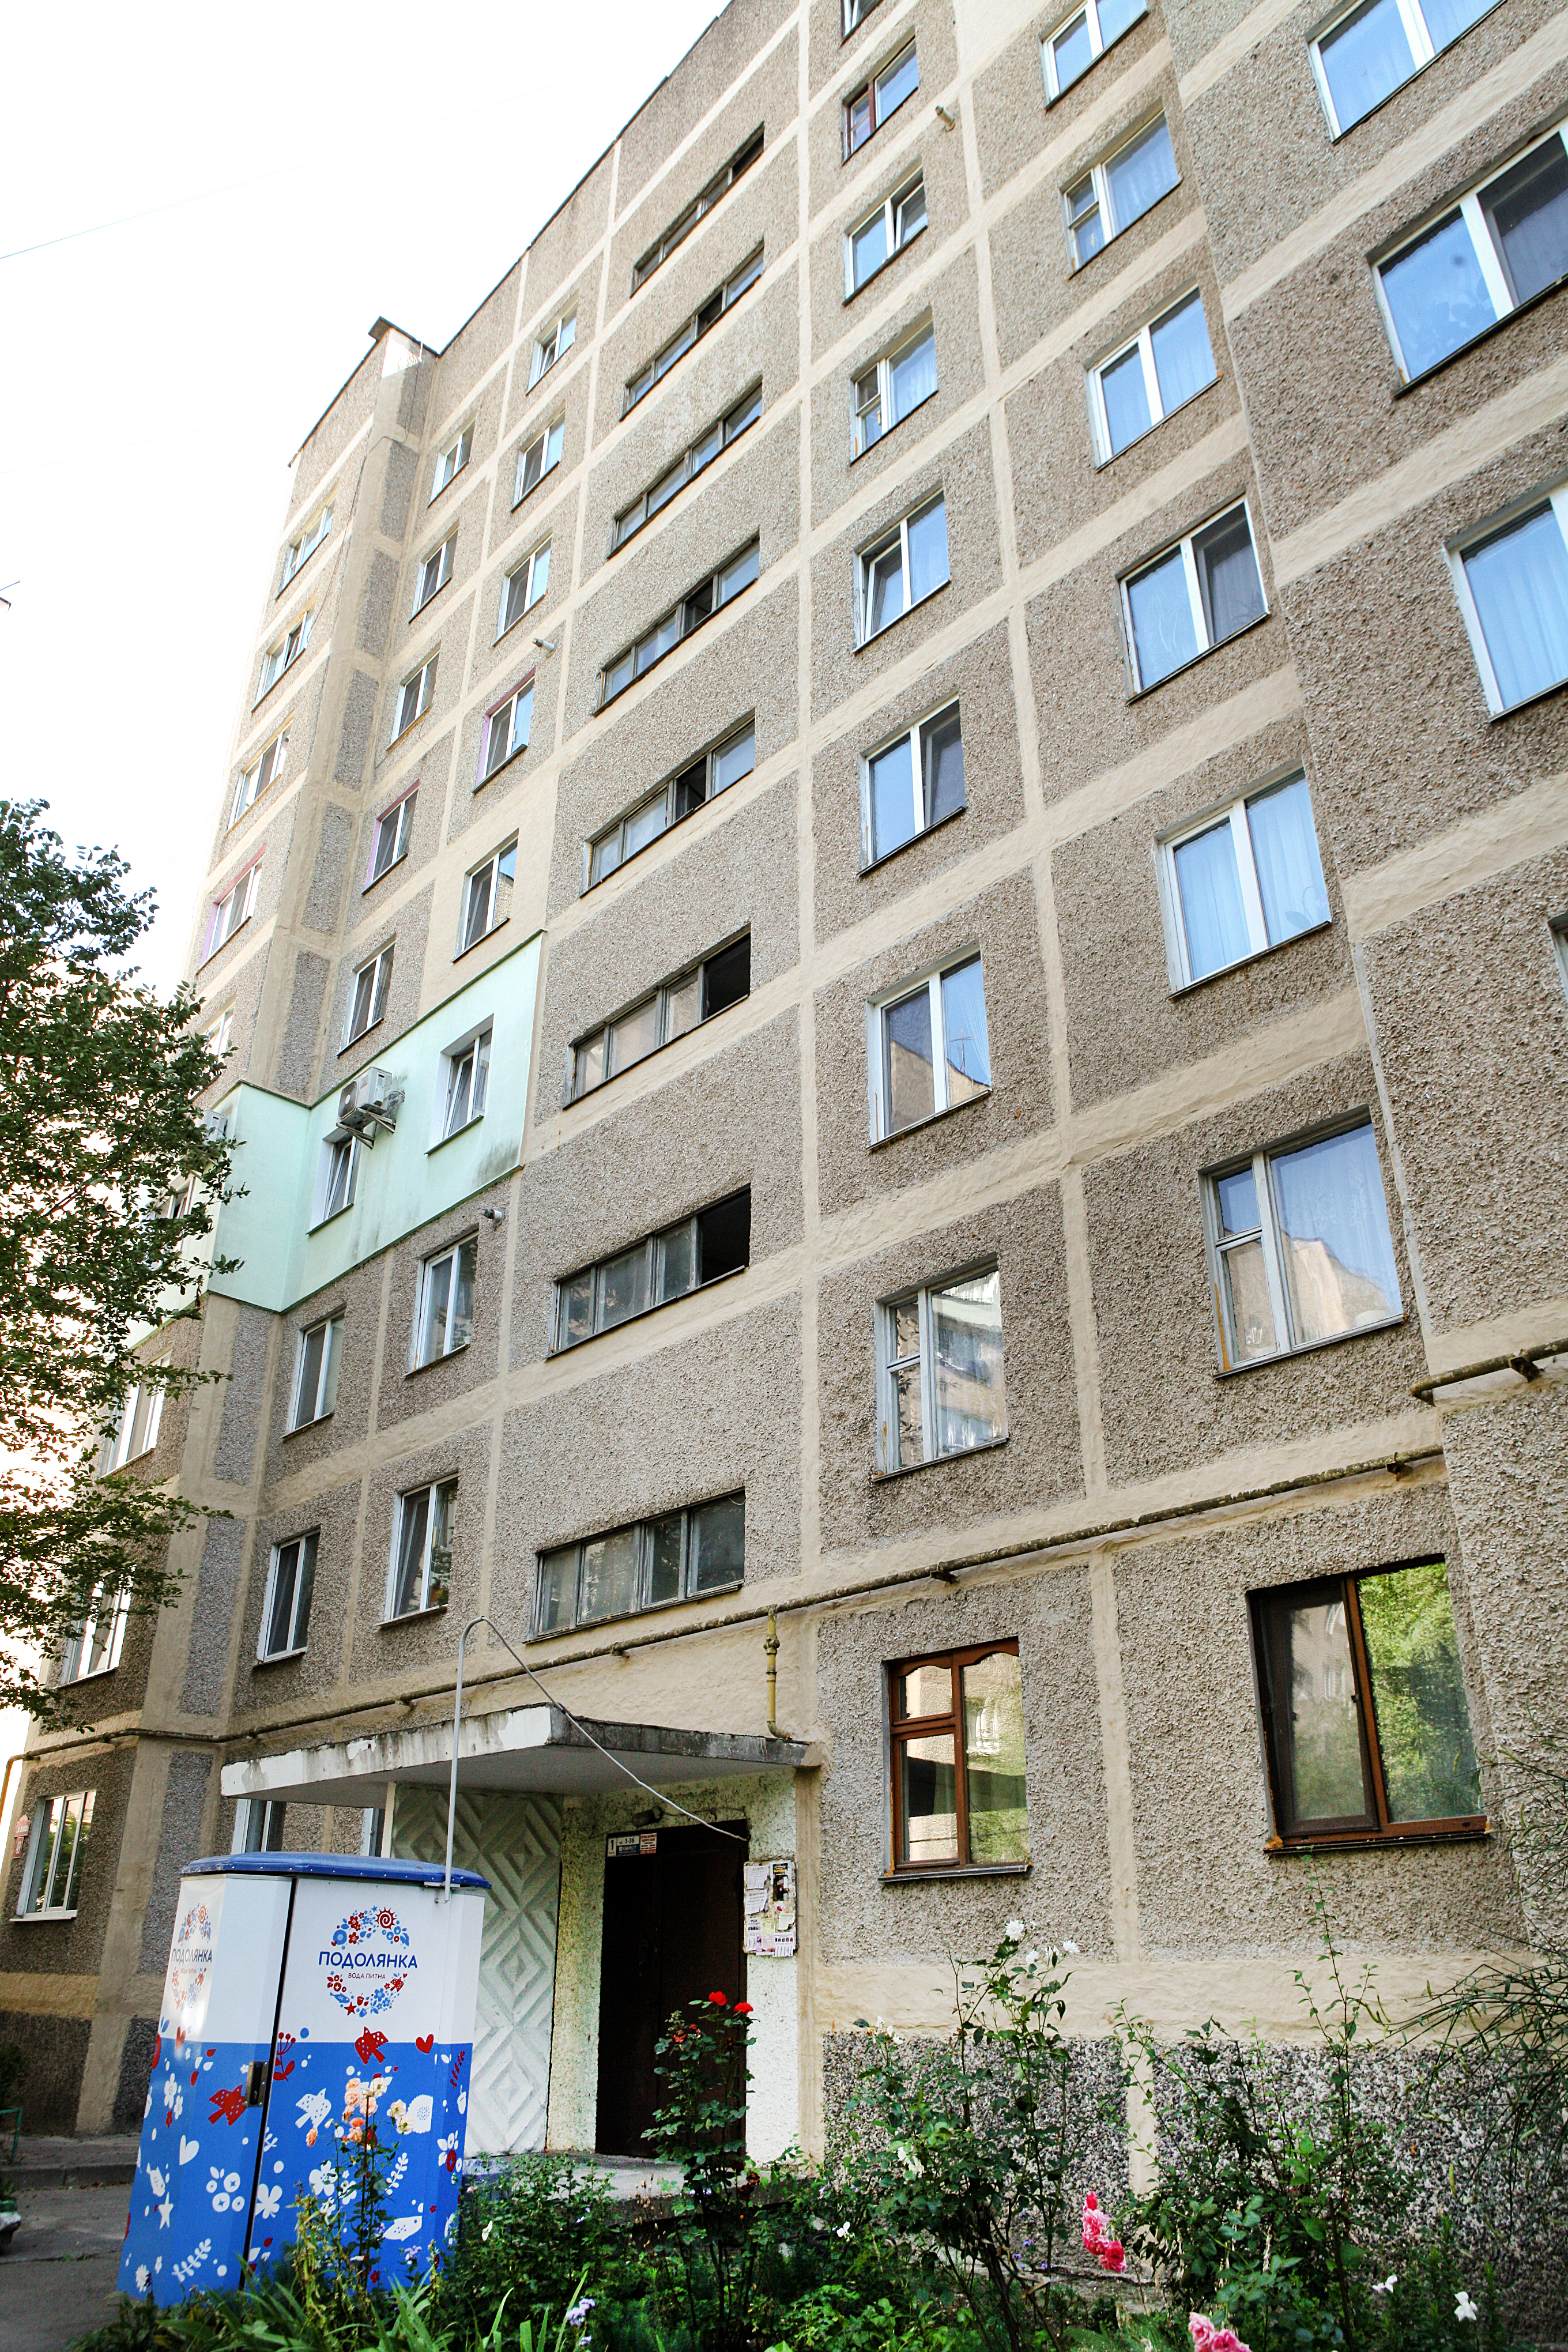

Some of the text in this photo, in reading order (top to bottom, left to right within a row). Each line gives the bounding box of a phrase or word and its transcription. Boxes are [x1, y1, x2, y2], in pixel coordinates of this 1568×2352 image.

[610, 1840, 614, 1850] 1
[171, 1948, 212, 1965] ПОДОЛЯНКА
[318, 1951, 417, 1969] ПОДОЛЯНКА
